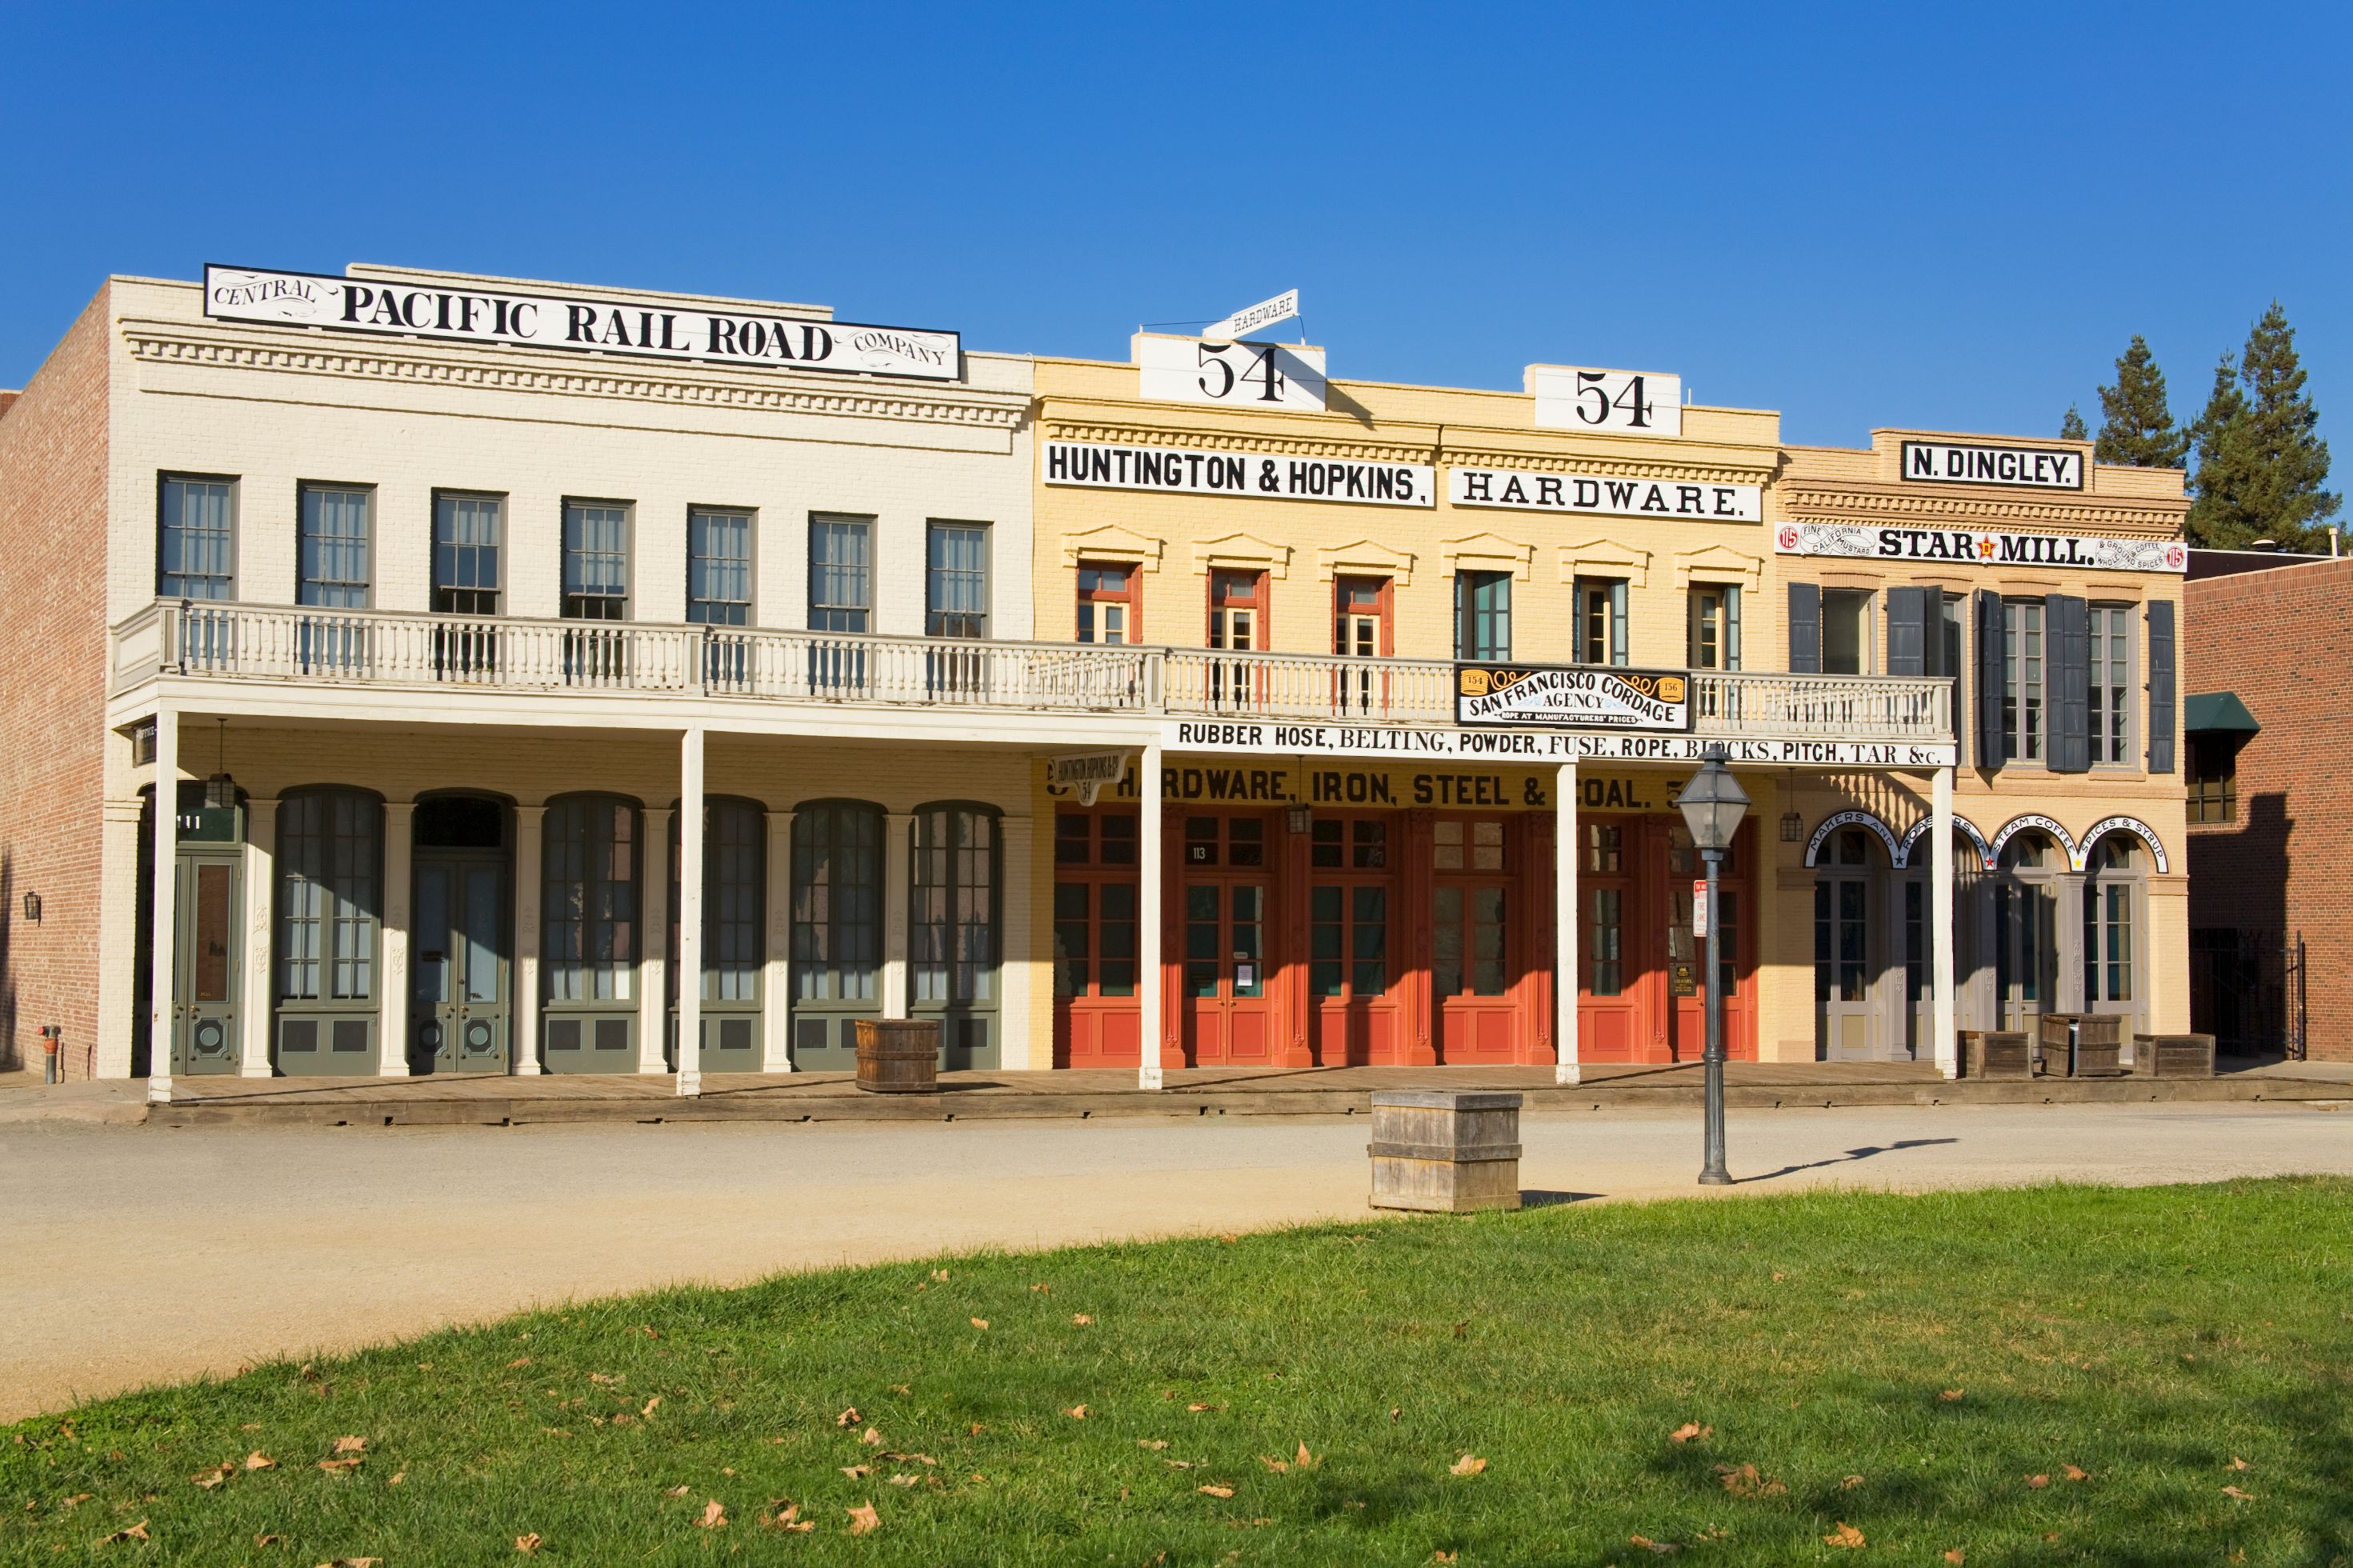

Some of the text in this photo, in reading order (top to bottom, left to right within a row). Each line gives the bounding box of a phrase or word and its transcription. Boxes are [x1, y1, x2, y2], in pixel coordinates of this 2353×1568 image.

[214, 279, 946, 366] CENTRAL PACIFIC RAIL ROAD COMPANY
[1234, 297, 1294, 333] HARDWARE
[1199, 342, 1284, 402] 54
[1576, 371, 1652, 428] 54
[1049, 446, 1427, 505] HUNTINGTON & HOPKINS,
[1914, 448, 2071, 483] N. DINGLEY.
[1463, 472, 1743, 517] HARDWARE.
[1803, 525, 1822, 536] FINE
[1813, 528, 1861, 552] CALIFORNIA
[1837, 538, 1870, 554] MUSTARD
[1879, 530, 1975, 559] STAR
[2135, 542, 2160, 553] COFFEE
[2000, 535, 2095, 566] MILL.
[2097, 554, 2120, 566] WHOLE
[2099, 541, 2163, 568] & GROUND SPICES
[1468, 676, 1483, 685] 154
[1470, 672, 1675, 722] SAN FRANCISCO CORDAGE
[1664, 682, 1678, 691] 156
[1543, 693, 1603, 709] AGENCY
[1179, 724, 1263, 746] RUBBER
[1275, 726, 1334, 750] HOSE,
[1339, 729, 1453, 755] BELTING,
[1460, 734, 1543, 756] POWDER,
[1548, 735, 1614, 758] FUSE,
[1622, 738, 1679, 759] ROPE,
[1783, 742, 1845, 763] PITCH,
[1851, 744, 1896, 764] TAR
[1118, 767, 1295, 802] HRDWARE,
[1312, 771, 1397, 806] IRON,
[1414, 774, 1509, 805] STEEL
[1524, 778, 1546, 806] &
[1811, 813, 1893, 851] MAKERS AND
[1903, 817, 1987, 852] ROASRS OF
[1993, 817, 2074, 852] STEAM COFFEE
[2081, 818, 2163, 858] SPICES & SYRUP
[1193, 847, 1205, 859] 113
